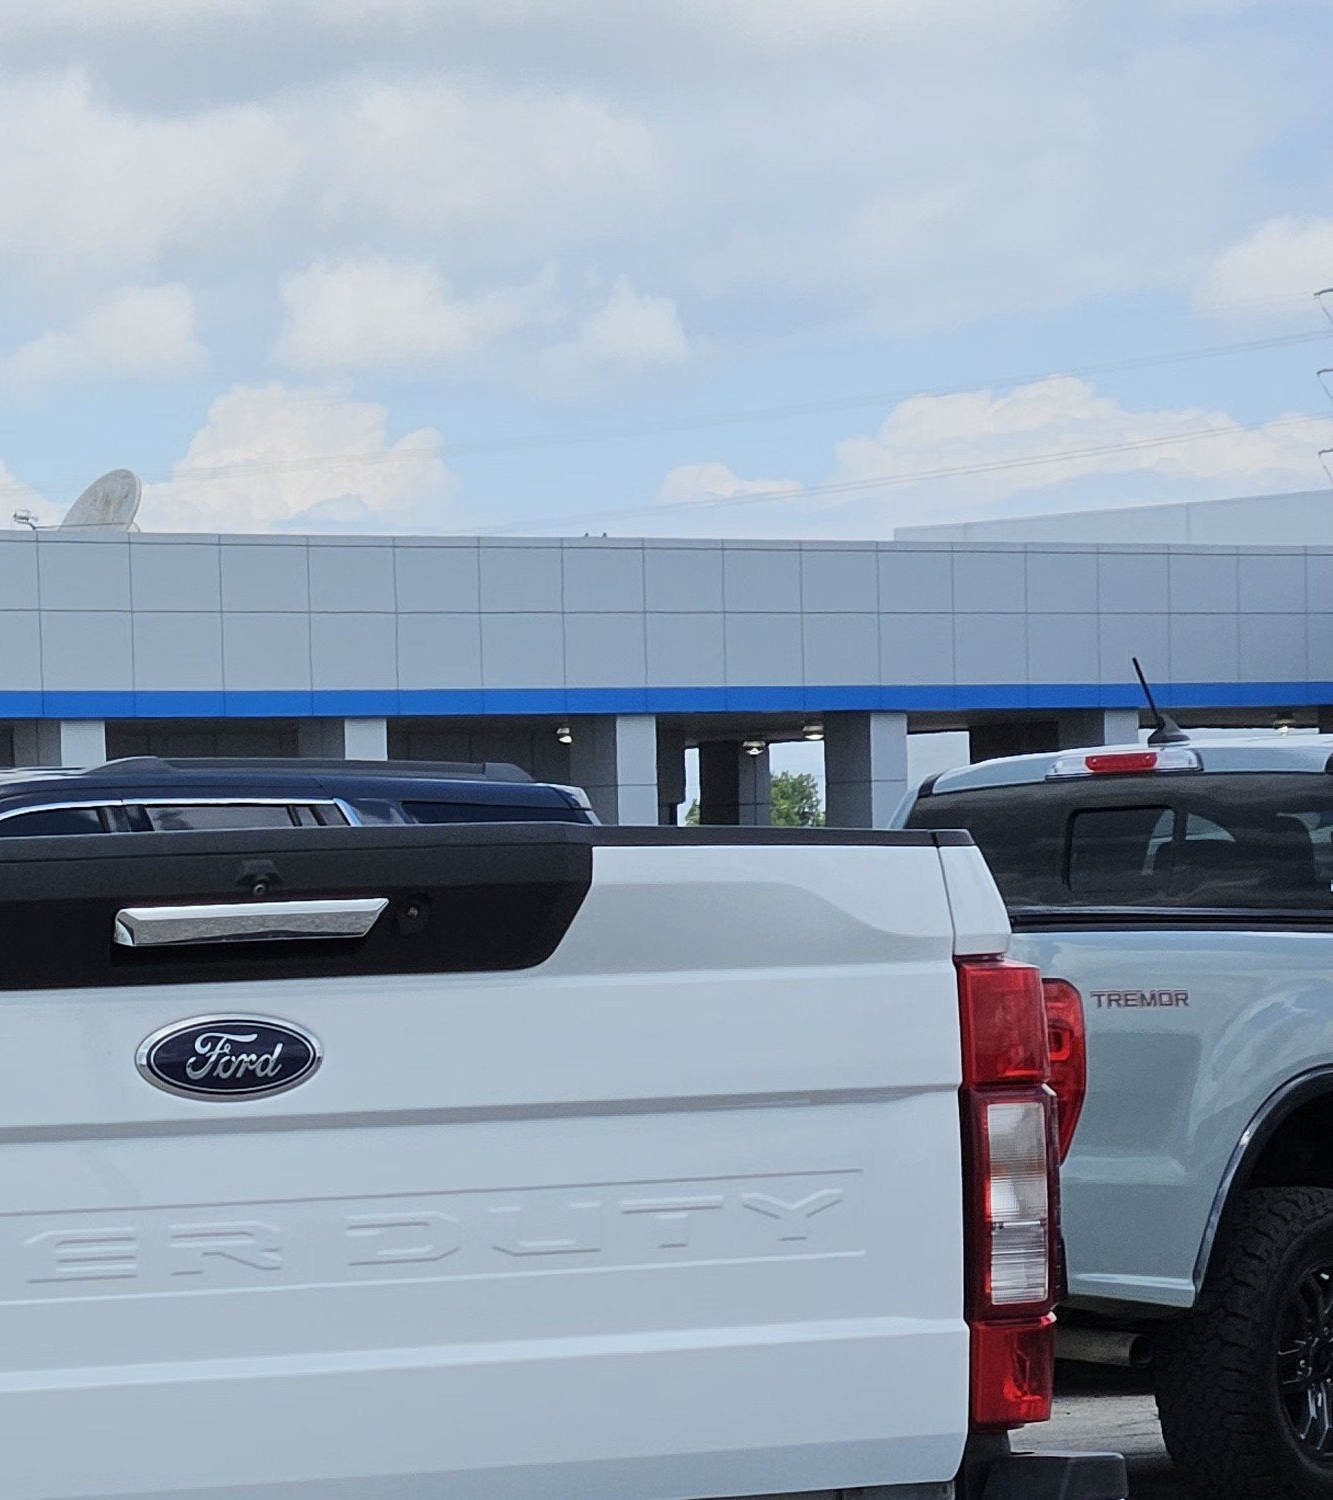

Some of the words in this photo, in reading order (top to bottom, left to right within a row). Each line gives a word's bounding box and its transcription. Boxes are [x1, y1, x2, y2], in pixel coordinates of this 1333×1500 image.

[1090, 990, 1190, 1008] TREMOR
[185, 1032, 283, 1080] Ford
[343, 1186, 844, 1267] DUTY
